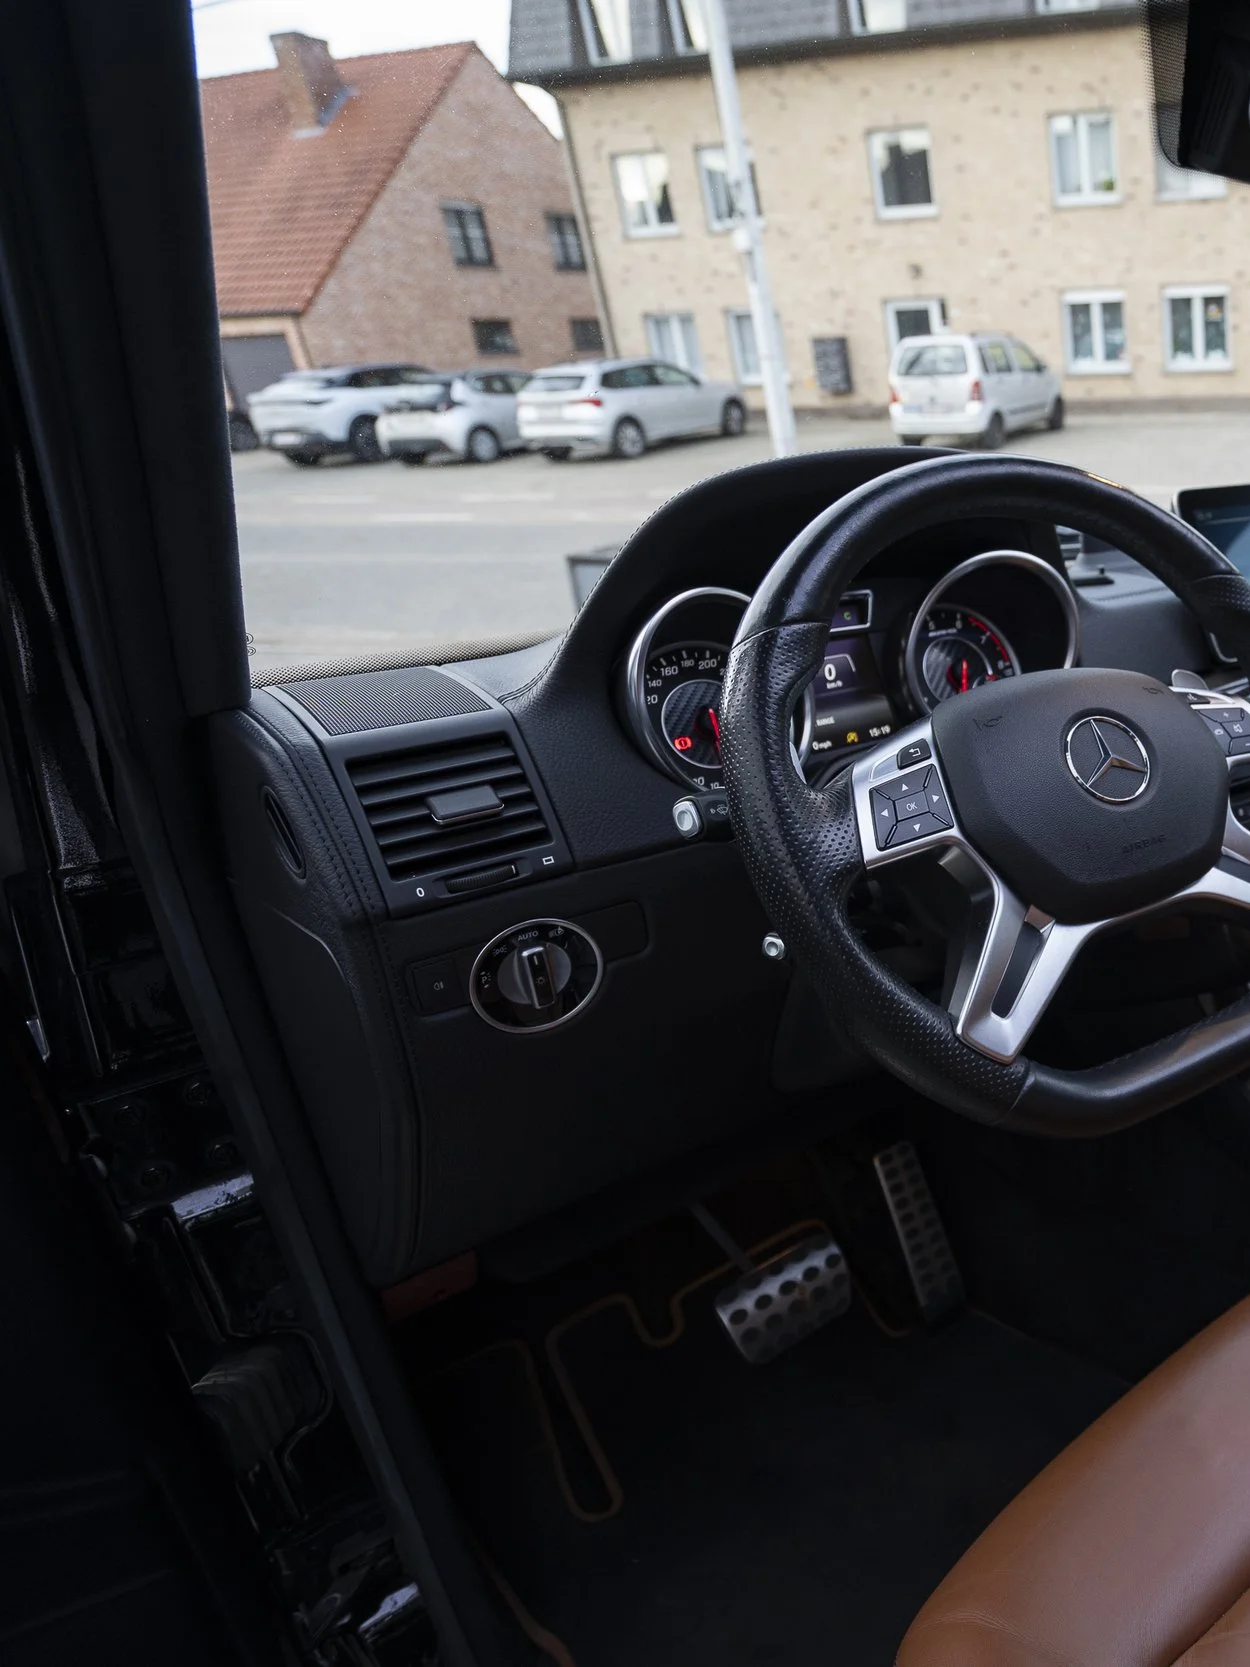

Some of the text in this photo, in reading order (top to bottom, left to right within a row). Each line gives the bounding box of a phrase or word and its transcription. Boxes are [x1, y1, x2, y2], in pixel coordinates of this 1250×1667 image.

[698, 659, 717, 669] 200
[660, 666, 678, 676] 160
[824, 664, 836, 680] 0
[647, 694, 658, 704] 20
[906, 802, 917, 811] OK
[518, 931, 539, 941] AUTO
